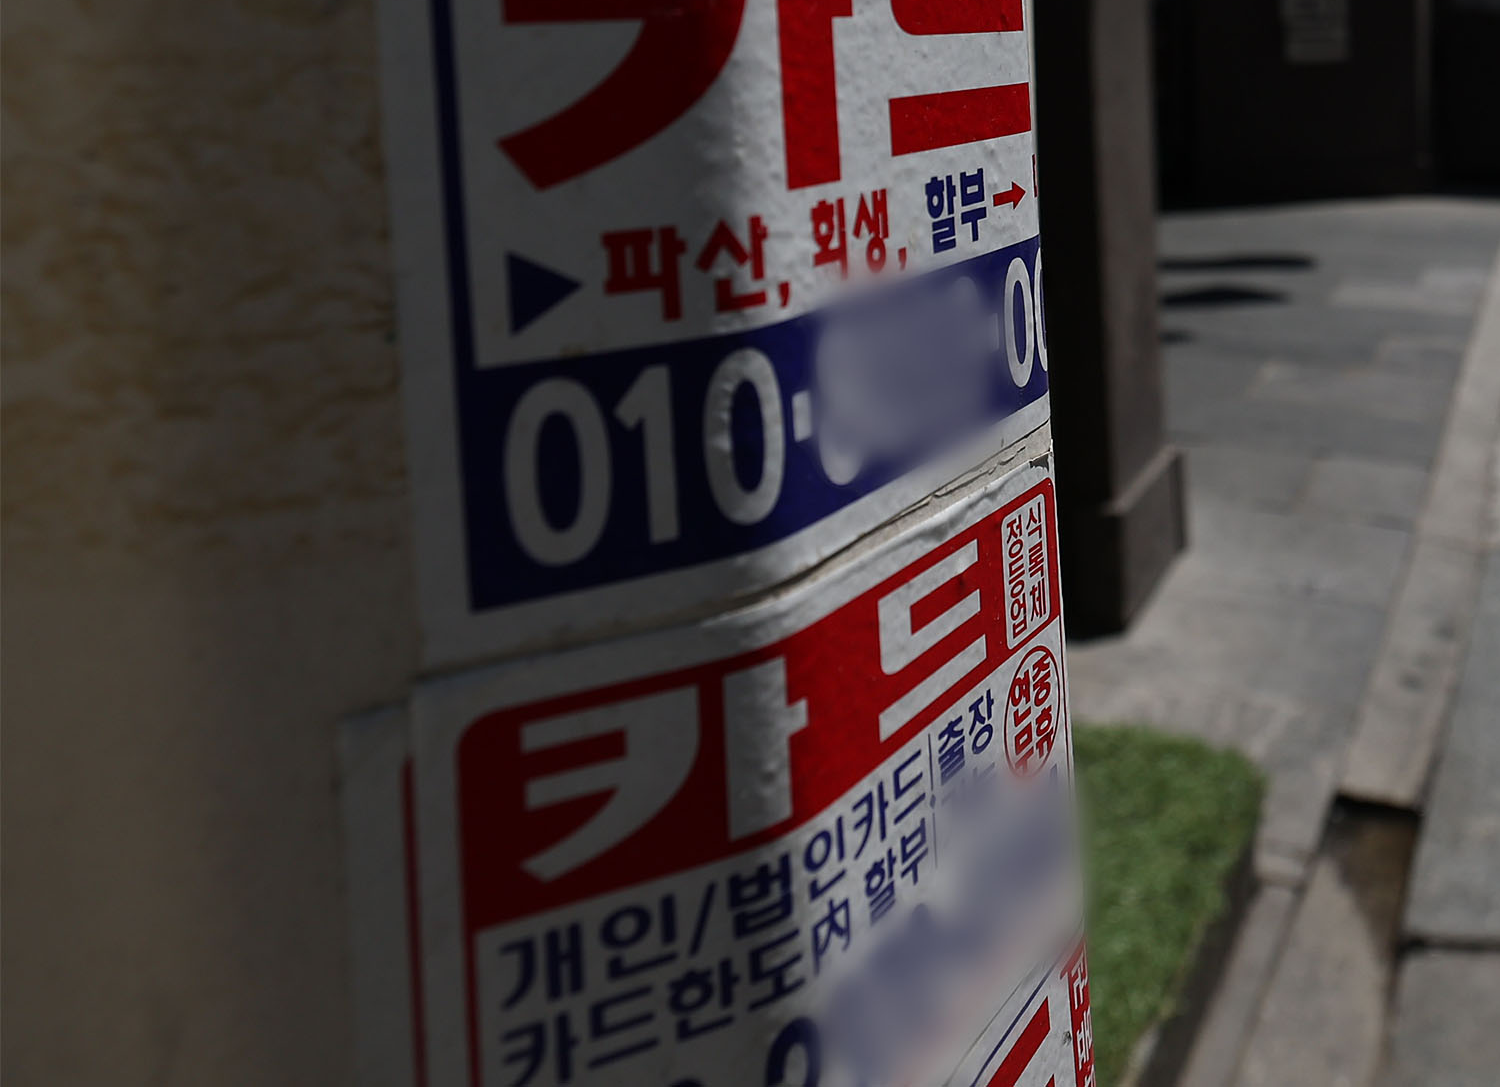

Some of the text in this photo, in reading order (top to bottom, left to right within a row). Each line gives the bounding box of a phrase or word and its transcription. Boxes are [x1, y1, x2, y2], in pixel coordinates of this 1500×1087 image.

[602, 167, 988, 324] 파산, 회생, 할부
[520, 537, 990, 884] 카드
[937, 688, 995, 787] 출장
[499, 748, 926, 1011] 개인/법인카드
[863, 825, 930, 926] 할부
